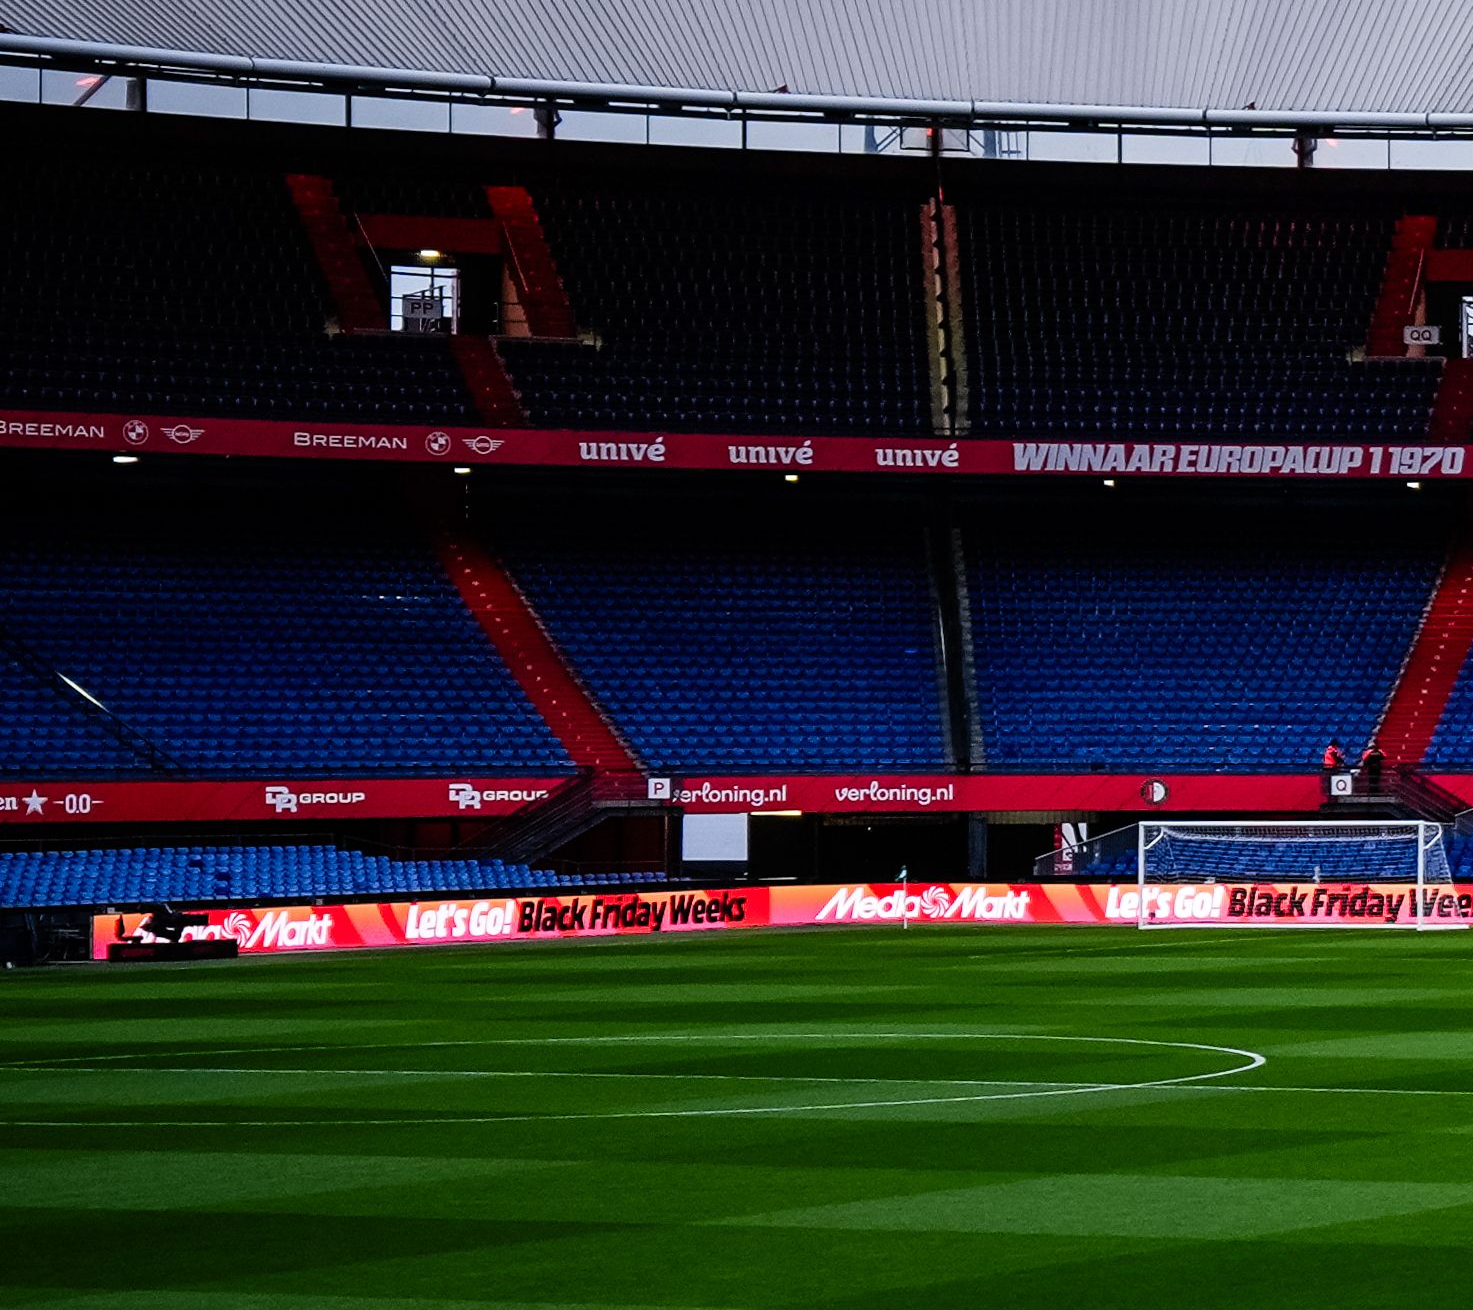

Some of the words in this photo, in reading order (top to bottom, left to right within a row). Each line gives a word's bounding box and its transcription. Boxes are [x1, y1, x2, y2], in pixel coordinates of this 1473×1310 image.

[411, 302, 434, 315] PP
[1410, 330, 1432, 341] QQ
[0, 420, 105, 438] BREEMAN
[293, 431, 409, 450] BREEMAN
[579, 436, 667, 462] univé
[728, 440, 815, 466] univé
[875, 443, 960, 469] univé
[1013, 443, 1177, 472] WINNAAR
[1176, 444, 1367, 474] EUROPACUP
[1387, 446, 1466, 475] 1970
[654, 782, 665, 795] P
[835, 781, 955, 805] verloning.nl
[1335, 779, 1347, 792] Q
[299, 792, 366, 805] GROUP
[1104, 884, 1164, 917] Let's
[1166, 884, 1225, 917] Go!
[1227, 886, 1306, 917] Black
[1311, 886, 1404, 921] Friday
[405, 904, 466, 942] Let's
[468, 901, 516, 938] Go!
[517, 898, 585, 934] Black
[588, 895, 665, 932] Friday
[670, 892, 746, 927] Weeks
